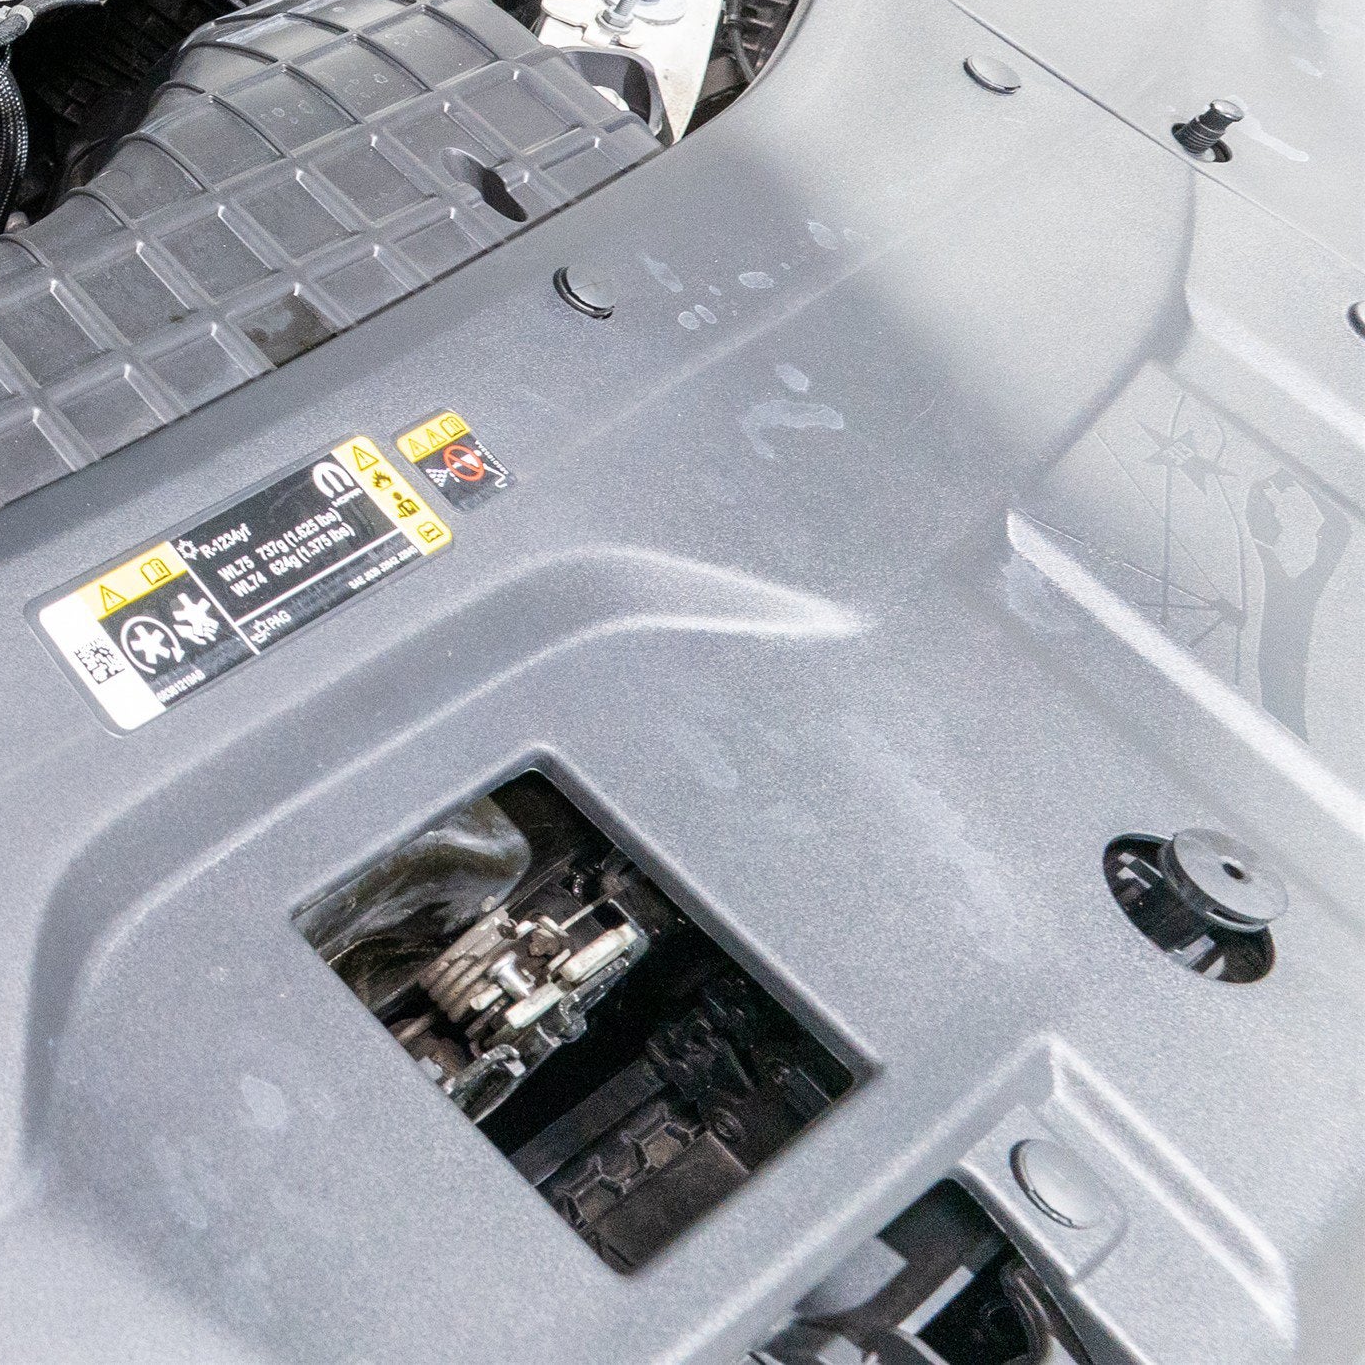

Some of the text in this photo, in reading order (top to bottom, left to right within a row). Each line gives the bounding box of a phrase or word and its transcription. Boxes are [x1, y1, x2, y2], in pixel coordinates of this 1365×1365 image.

[199, 522, 252, 559] R-1234yf
[217, 507, 343, 582] WL75 737g (1.625 lbs)
[230, 522, 356, 598] WL74 624g (1.375 lbs)
[348, 575, 367, 590] SAE
[266, 610, 292, 632] PAG
